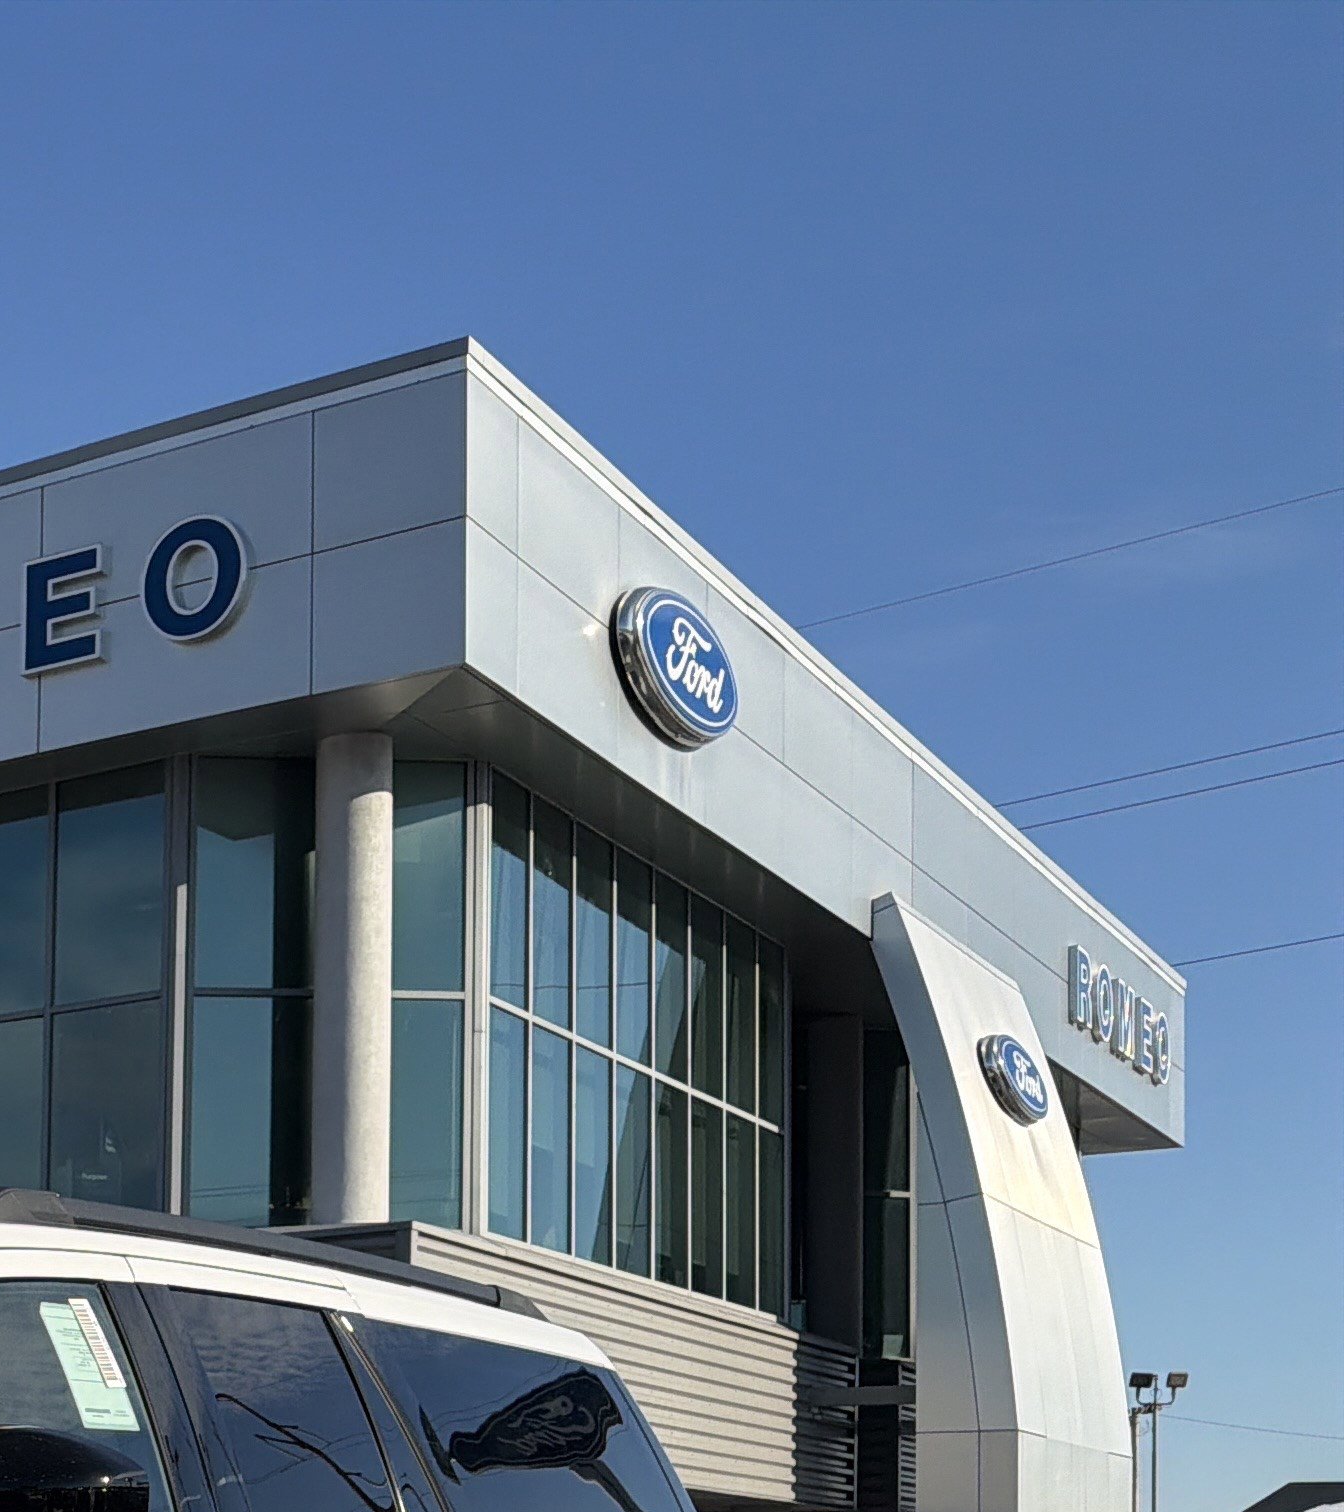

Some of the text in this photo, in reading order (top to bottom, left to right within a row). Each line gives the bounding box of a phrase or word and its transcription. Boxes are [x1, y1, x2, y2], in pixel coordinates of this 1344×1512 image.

[666, 616, 725, 713] Ford
[1069, 944, 1172, 1086] ROMEO
[1012, 1050, 1044, 1105] Ford
